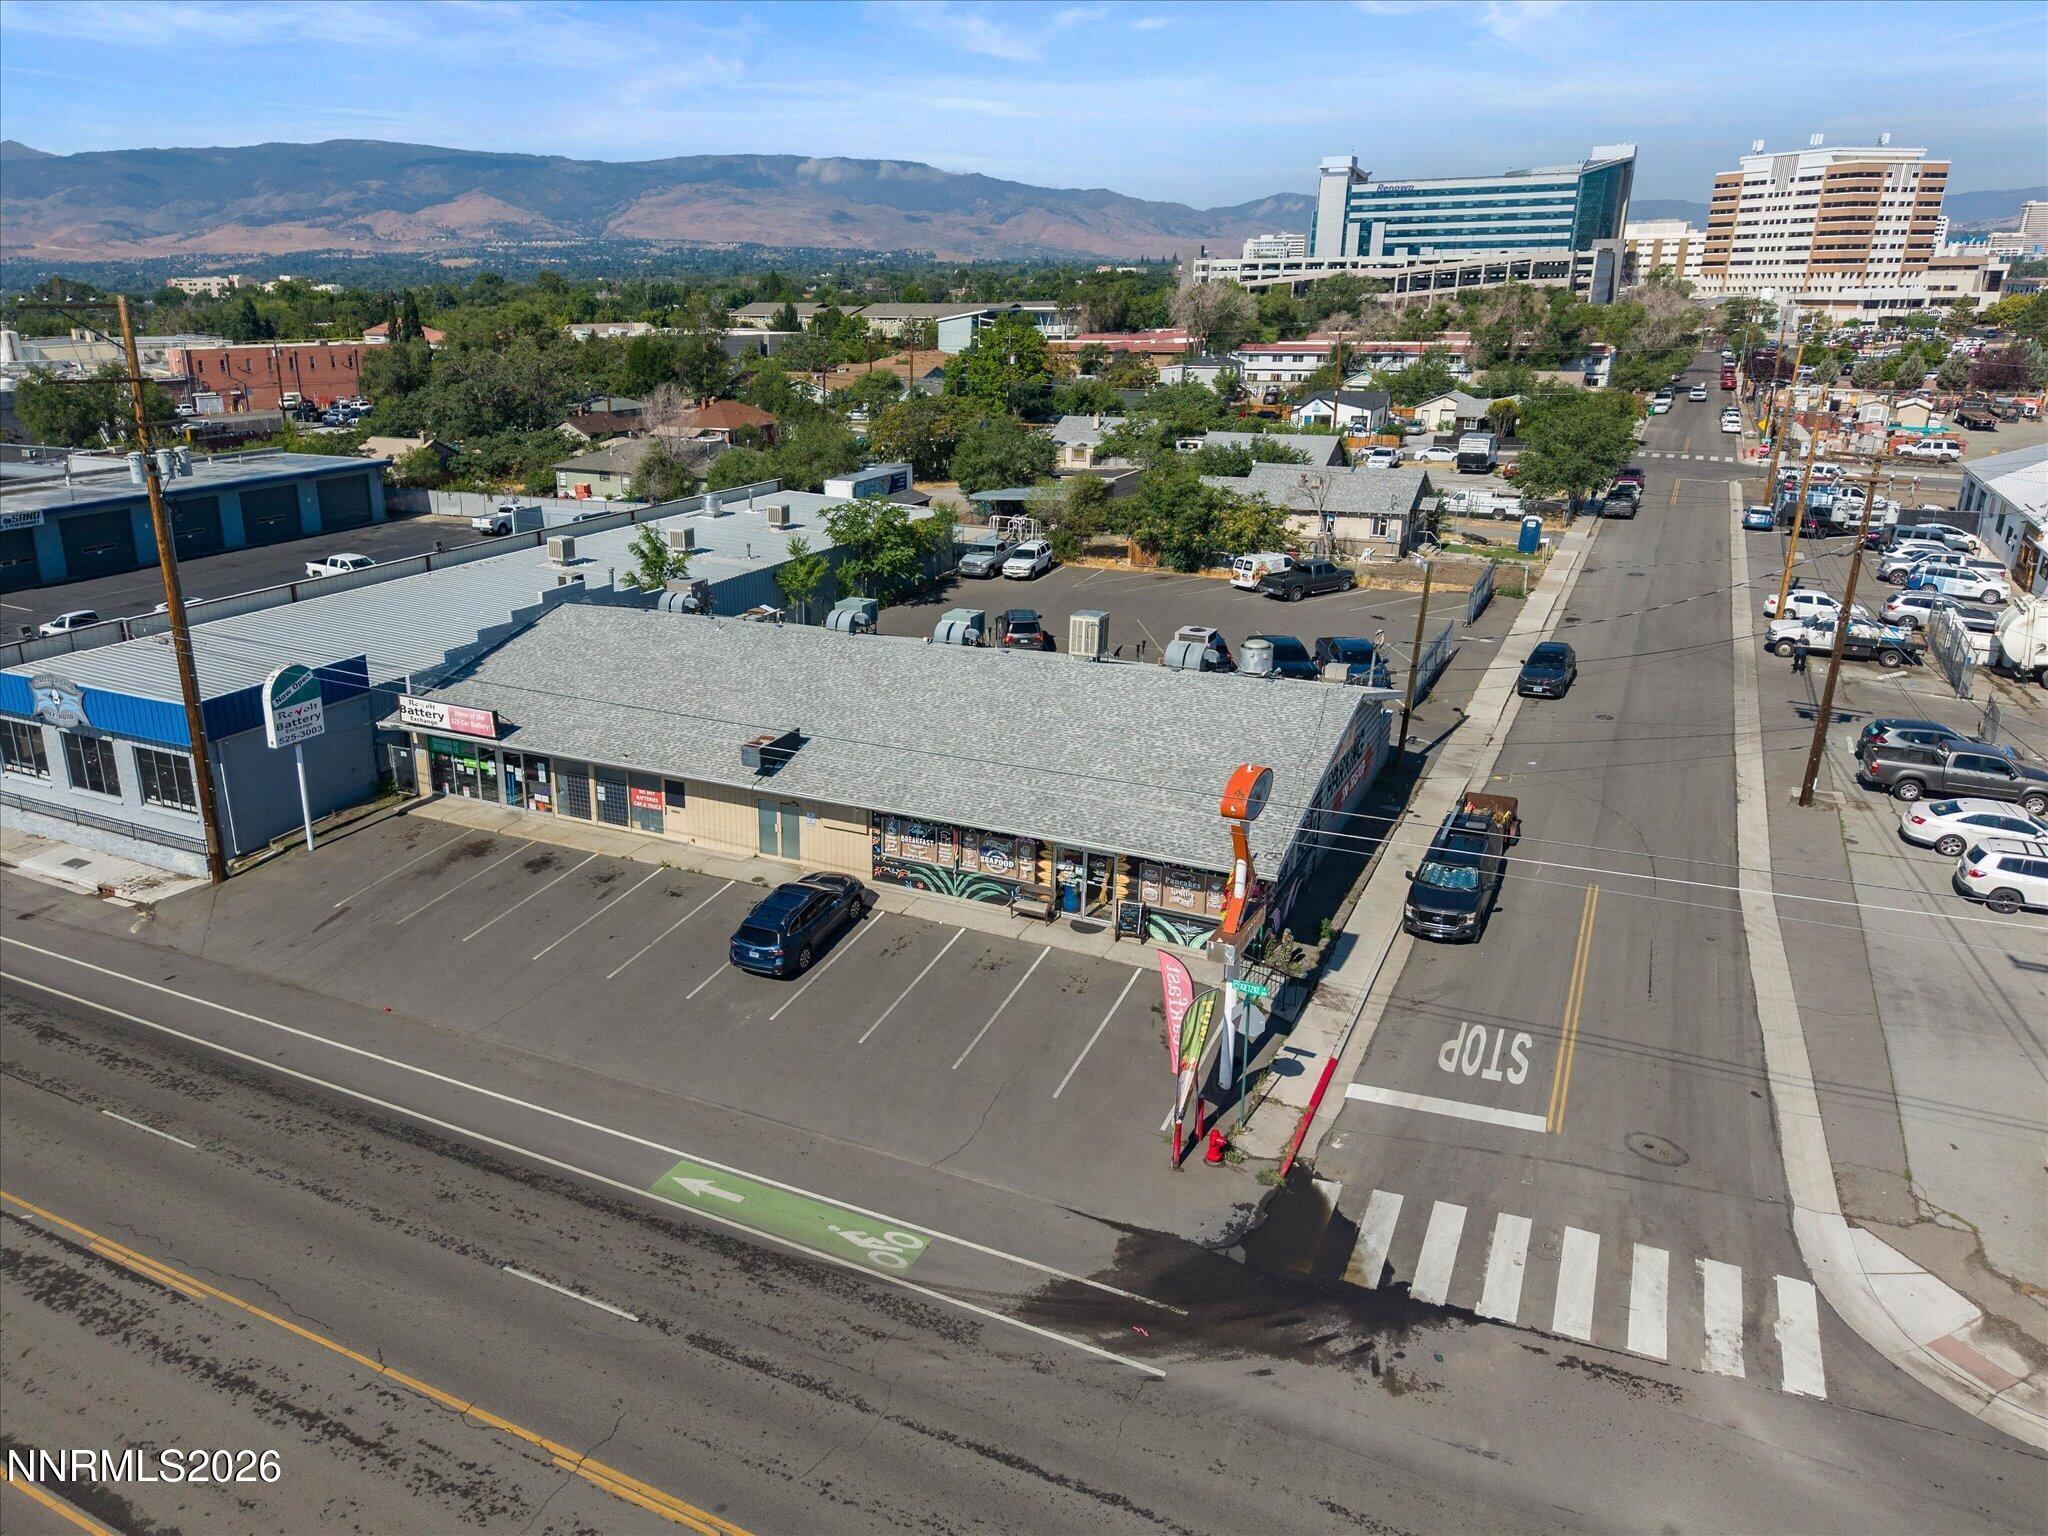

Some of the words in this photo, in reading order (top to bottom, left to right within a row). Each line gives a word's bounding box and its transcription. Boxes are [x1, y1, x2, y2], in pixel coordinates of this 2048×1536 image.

[12, 511, 40, 523] SAND
[276, 689, 291, 704] Now
[292, 673, 311, 690] Open
[400, 704, 445, 722] Battery
[454, 710, 469, 719] Home
[277, 712, 322, 731] Battery
[286, 721, 313, 733] Exchange
[410, 715, 439, 726] Exchange
[279, 725, 323, 745] 525-3003
[636, 795, 659, 803] BATTERIES
[900, 834, 935, 847] BREAKFAST
[980, 855, 1014, 868] SEAFOOD
[1165, 876, 1201, 889] Pancakes
[1438, 1022, 1533, 1085] STOP
